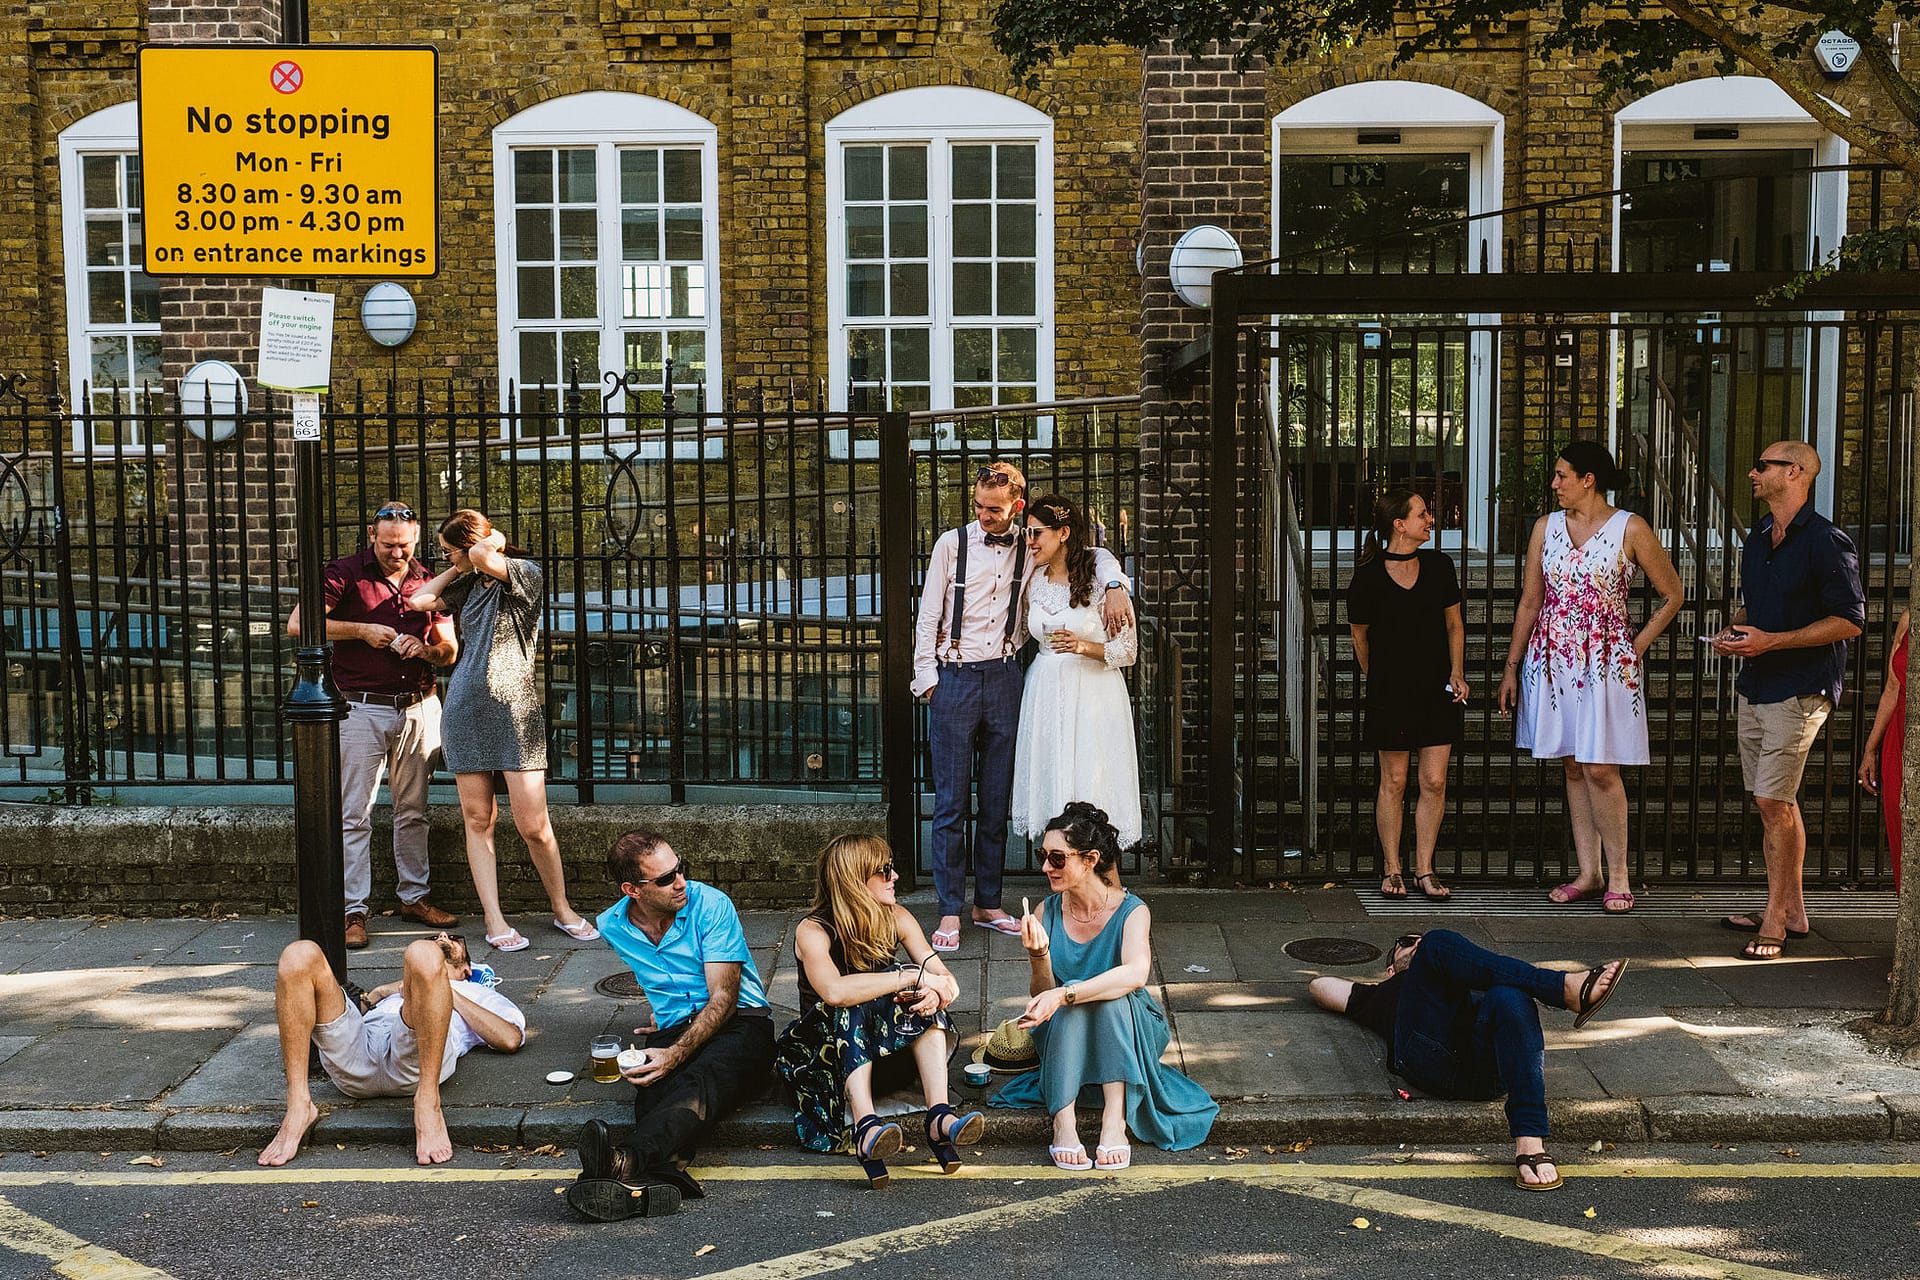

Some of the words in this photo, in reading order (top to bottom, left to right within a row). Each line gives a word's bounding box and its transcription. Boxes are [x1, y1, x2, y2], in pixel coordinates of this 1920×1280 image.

[187, 107, 232, 133] No
[246, 107, 390, 140] stopping
[236, 152, 288, 172] Mon
[311, 152, 342, 172] Fri
[177, 183, 236, 204] 8.30
[243, 188, 279, 204] am
[300, 184, 359, 204] 9.30
[366, 189, 402, 204] am
[175, 210, 235, 231] 3.00
[243, 215, 279, 234] pm
[300, 211, 360, 232] 4.30
[368, 216, 404, 235] pm
[155, 246, 184, 262] on
[194, 243, 303, 263] entrance
[313, 243, 426, 267] markings
[269, 312, 291, 320] Please
[296, 420, 314, 428] KC
[296, 428, 318, 436] 661
